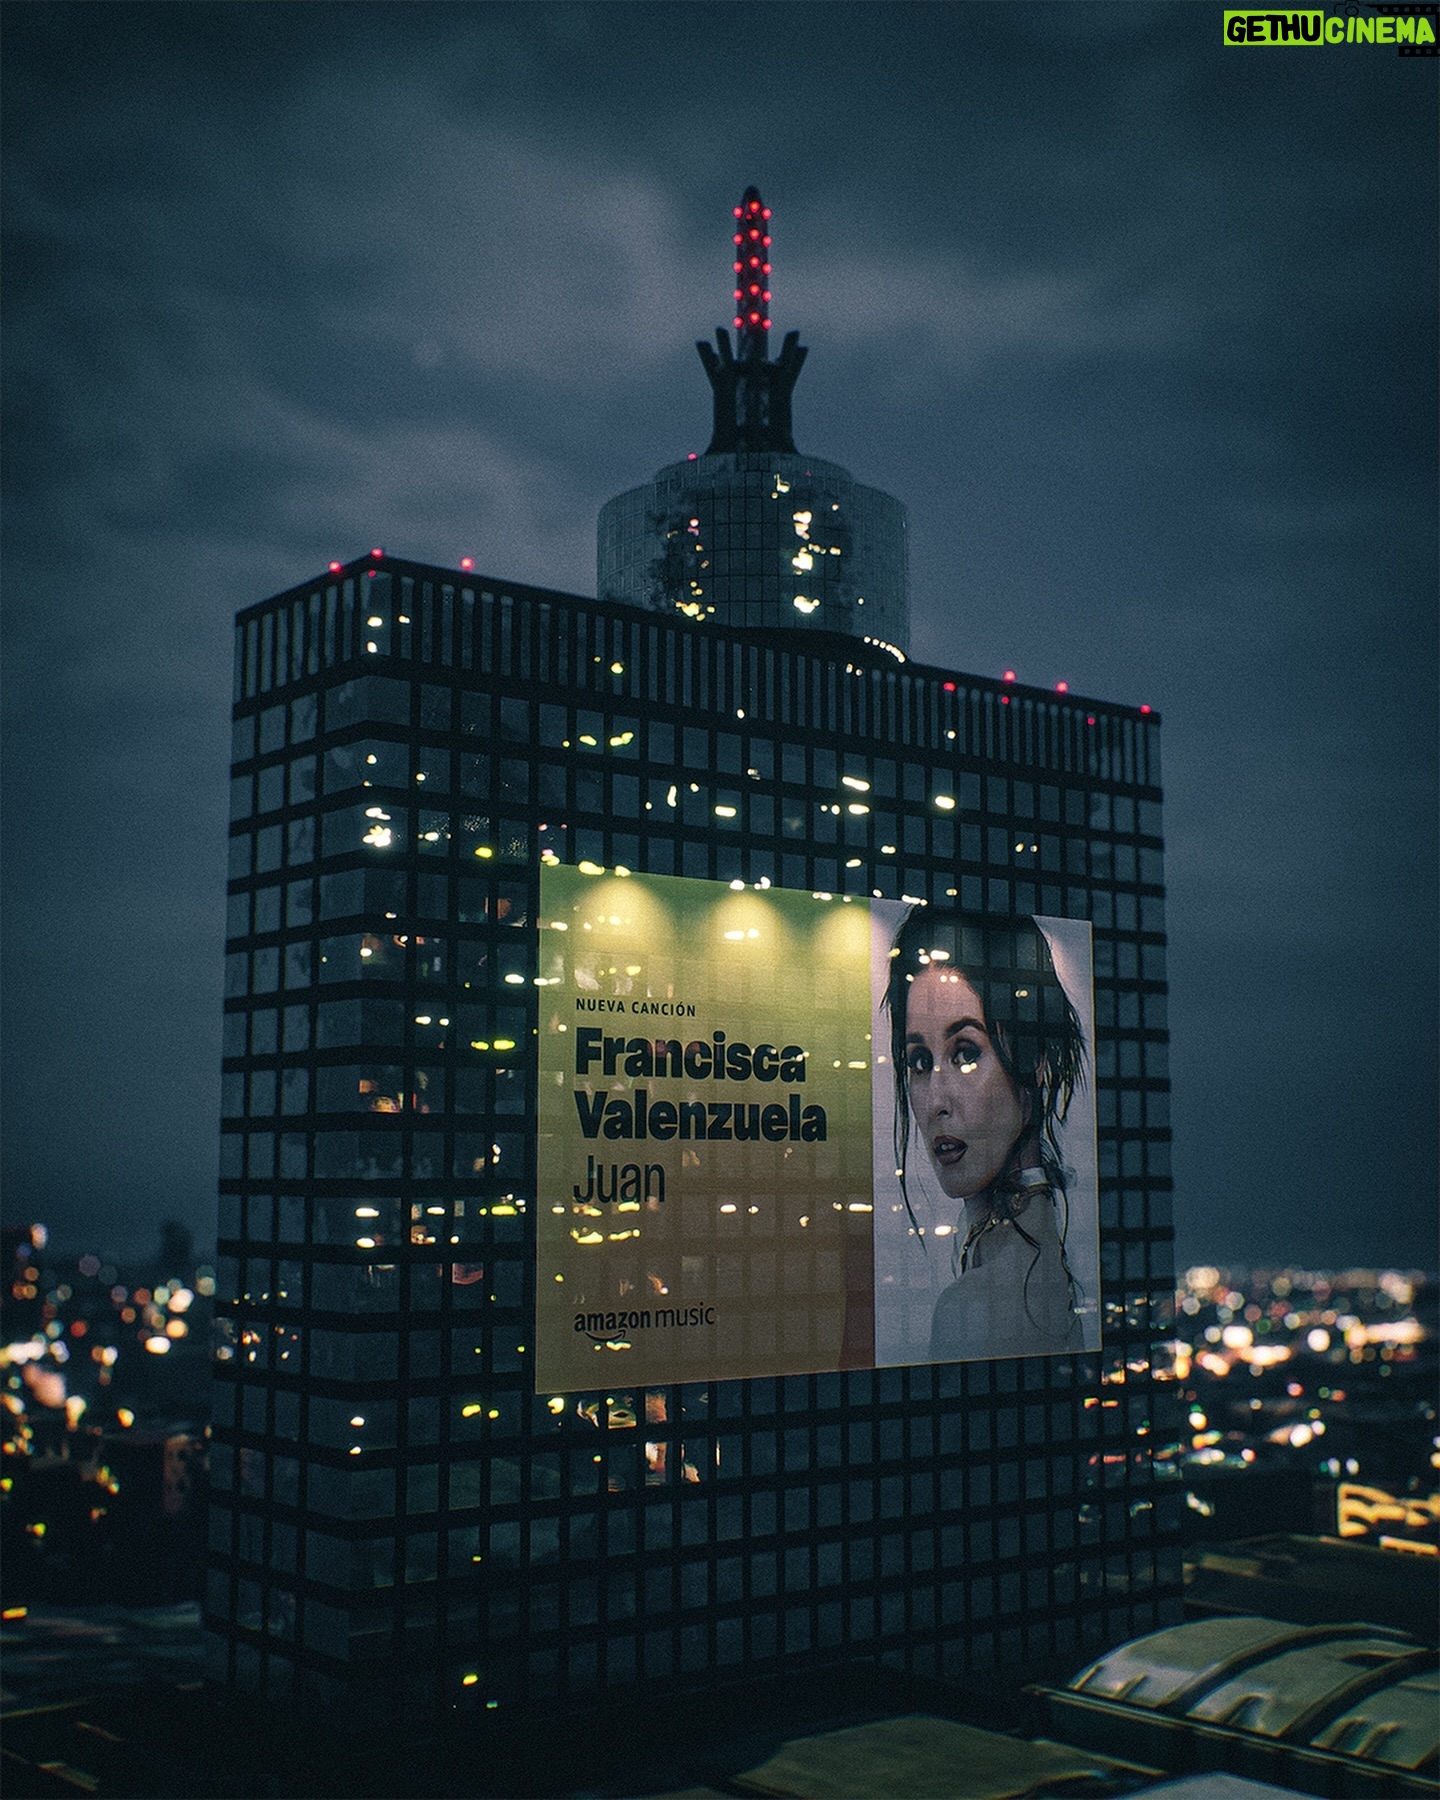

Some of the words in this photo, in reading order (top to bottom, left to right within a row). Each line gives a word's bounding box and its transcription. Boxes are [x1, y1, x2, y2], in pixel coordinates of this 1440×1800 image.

[576, 998, 625, 1013] NUEVA
[631, 1001, 696, 1017] CANCIÓN
[575, 1027, 806, 1082] Francisca
[574, 1089, 827, 1142] Valenzuela
[573, 1155, 665, 1203] Juan
[574, 1310, 651, 1332] amazon
[655, 1302, 715, 1328] music
